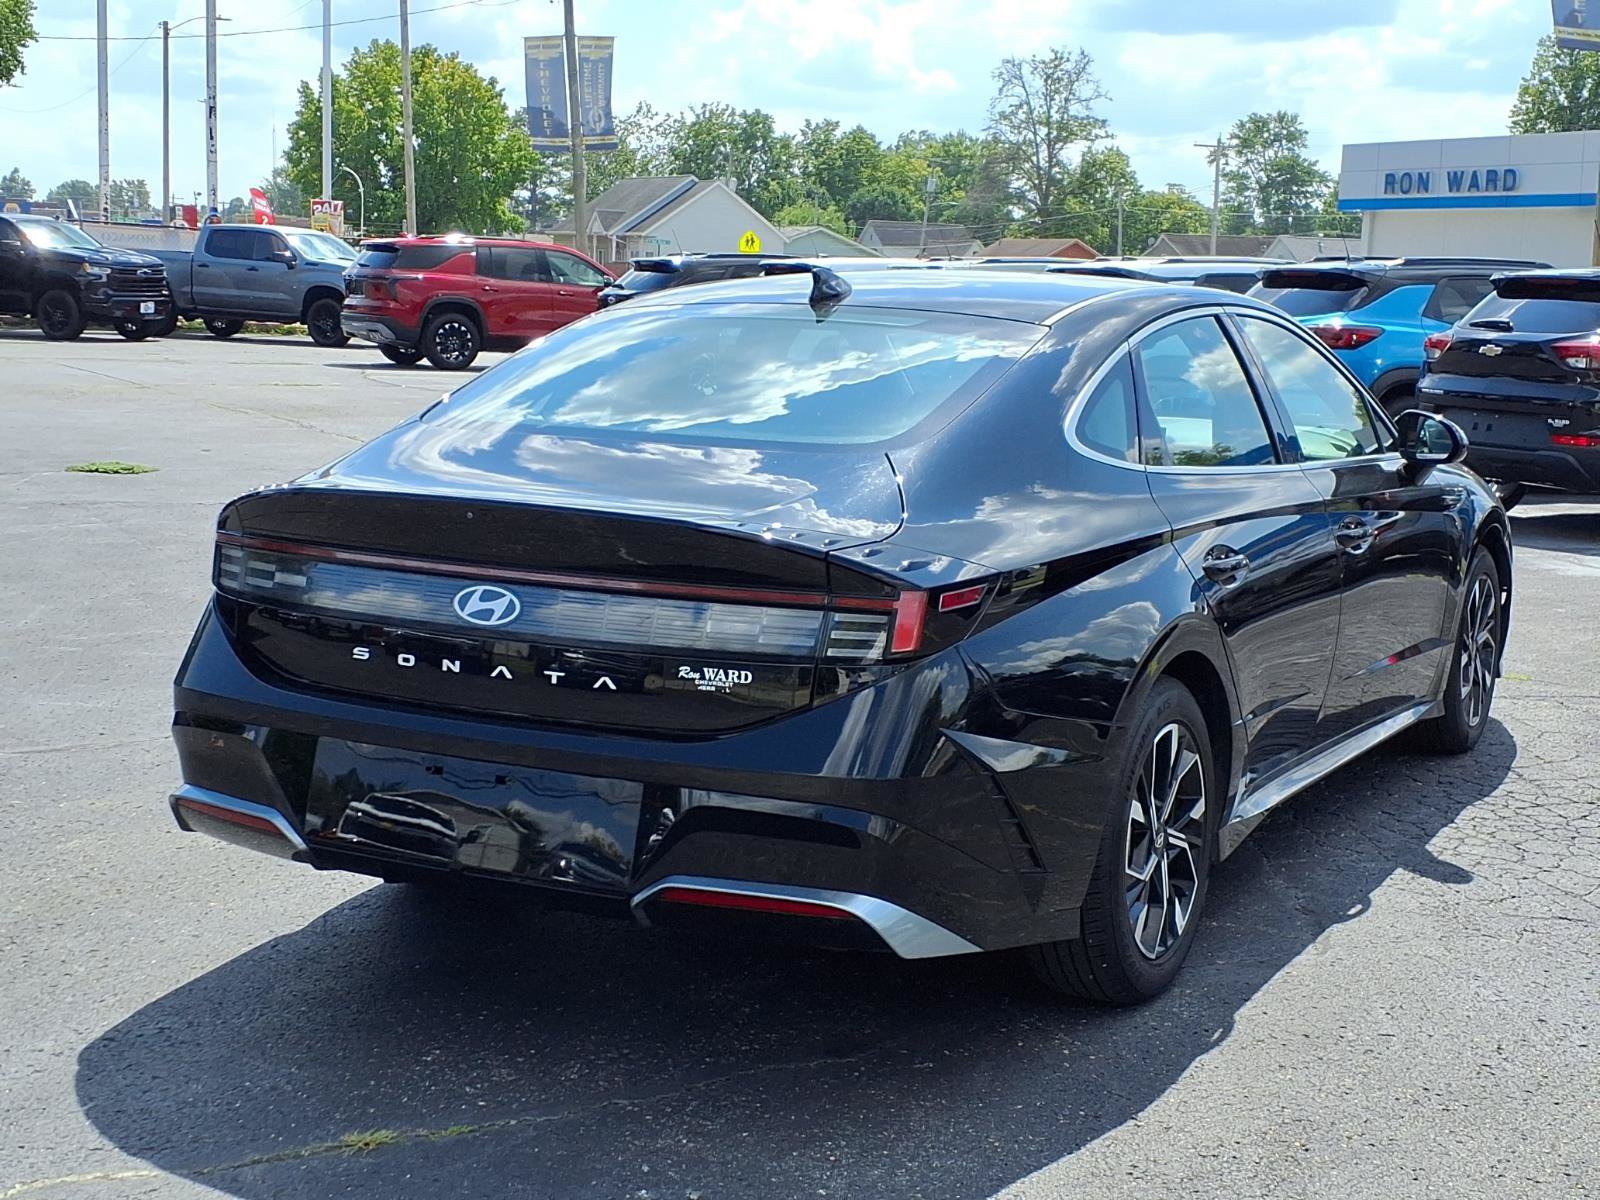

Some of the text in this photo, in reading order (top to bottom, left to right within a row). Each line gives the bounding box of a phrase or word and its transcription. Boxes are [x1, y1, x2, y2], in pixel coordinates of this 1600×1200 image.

[1383, 168, 1518, 195] RON WARD
[352, 646, 617, 690] SONATA
[678, 666, 753, 684] Ron WARD
[694, 679, 734, 687] CHEVROLET
